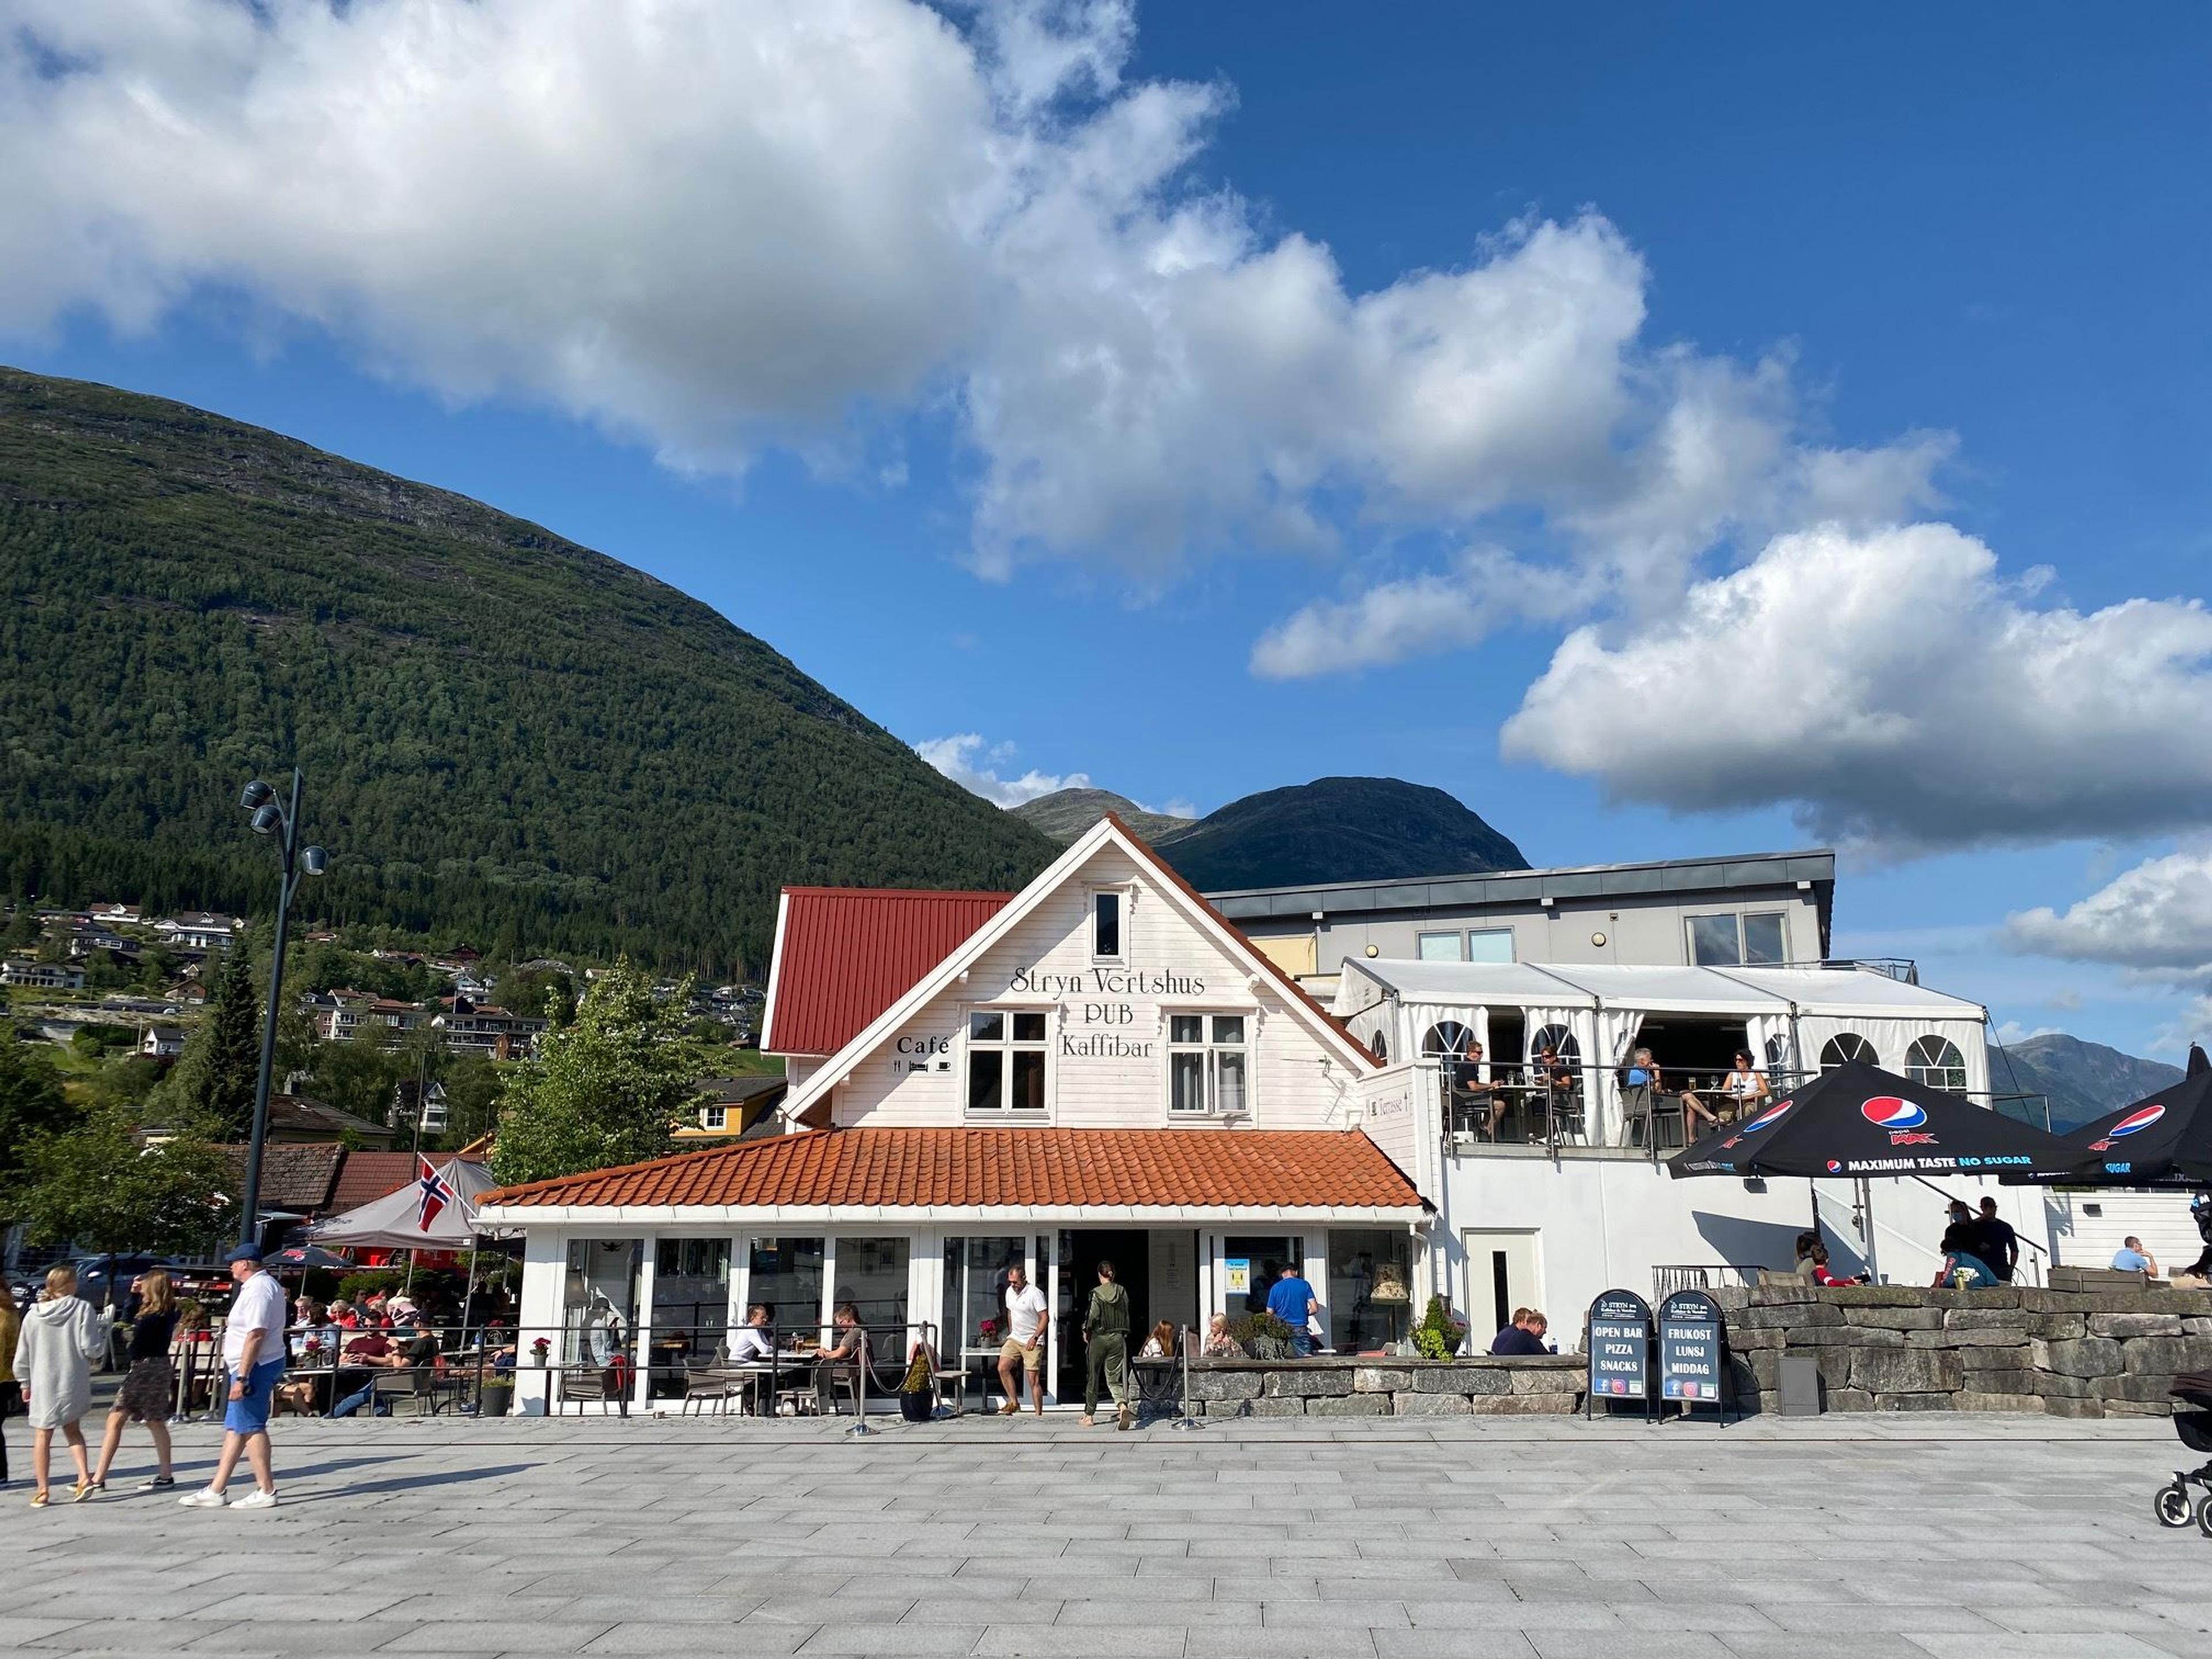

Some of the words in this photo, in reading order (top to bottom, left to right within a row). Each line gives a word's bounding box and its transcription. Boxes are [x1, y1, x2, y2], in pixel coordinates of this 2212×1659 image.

[1010, 967, 1082, 1000] Stryn
[1092, 968, 1205, 995] Vertshus
[1085, 1003, 1133, 1024] PUB
[897, 1036, 949, 1054] Café
[1062, 1033, 1153, 1058] Kaffibar
[1849, 1158, 1915, 1171] MAXIMUM
[1917, 1157, 1957, 1168] TASTE
[1959, 1157, 1981, 1166] NO
[1984, 1156, 2032, 1165] SUGAR
[2105, 1162, 2131, 1173] SUGAR
[1595, 1327, 1620, 1338] OPEN
[1623, 1327, 1643, 1338] BAR
[1668, 1328, 1711, 1340] FRUKOST
[1605, 1344, 1633, 1354] PIZZA
[1676, 1346, 1705, 1357] LUNSJ
[1600, 1361, 1638, 1372] SNACKS
[1672, 1363, 1710, 1374] MIDDAG
